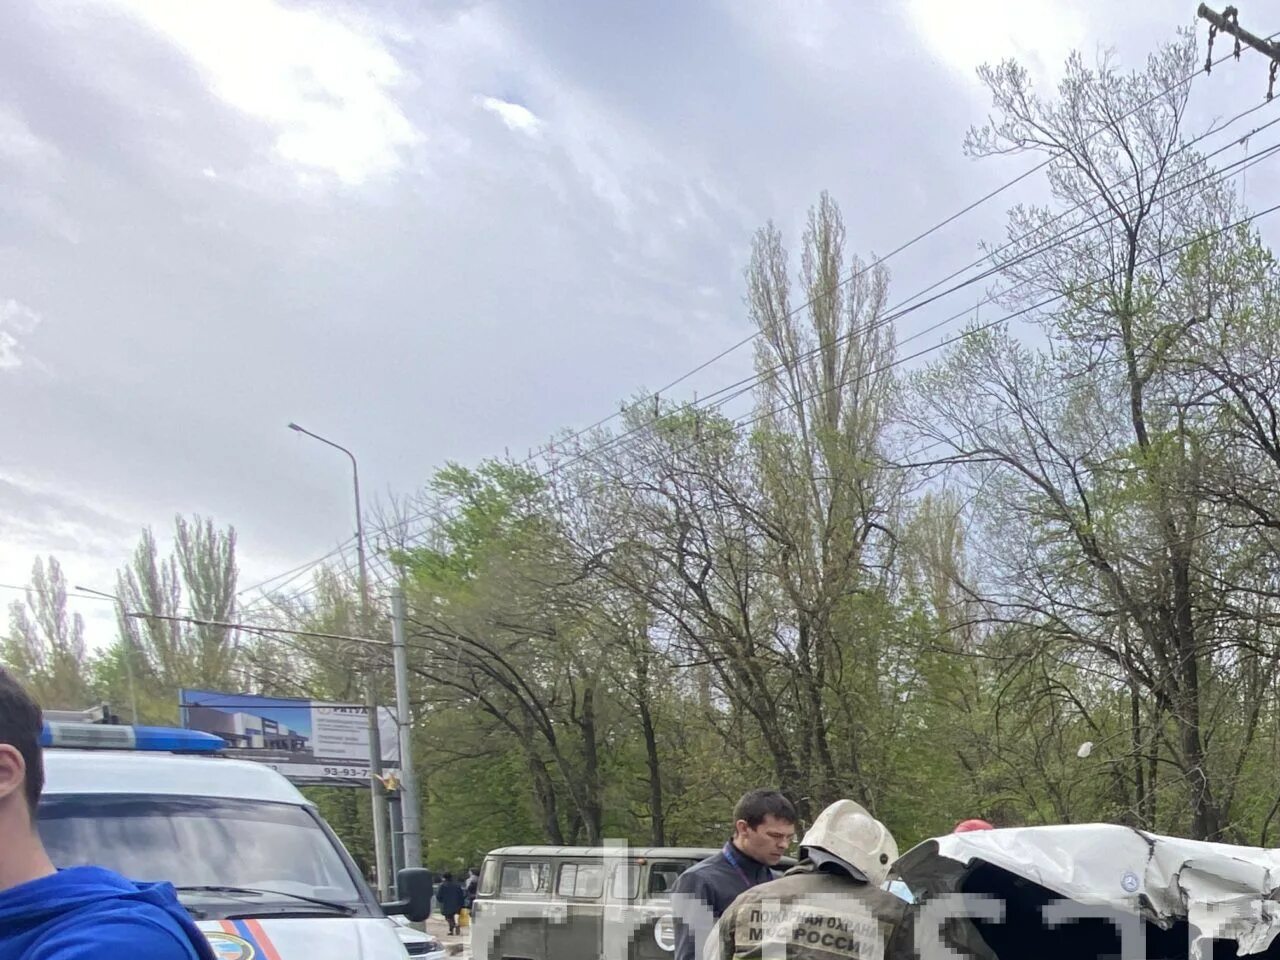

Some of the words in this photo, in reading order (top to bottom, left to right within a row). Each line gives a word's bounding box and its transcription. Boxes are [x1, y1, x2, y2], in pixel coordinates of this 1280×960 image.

[324, 768, 370, 777] 93-93-7
[750, 909, 823, 928] ПОЖАРНАЯ
[793, 928, 877, 956] РОССИИ
